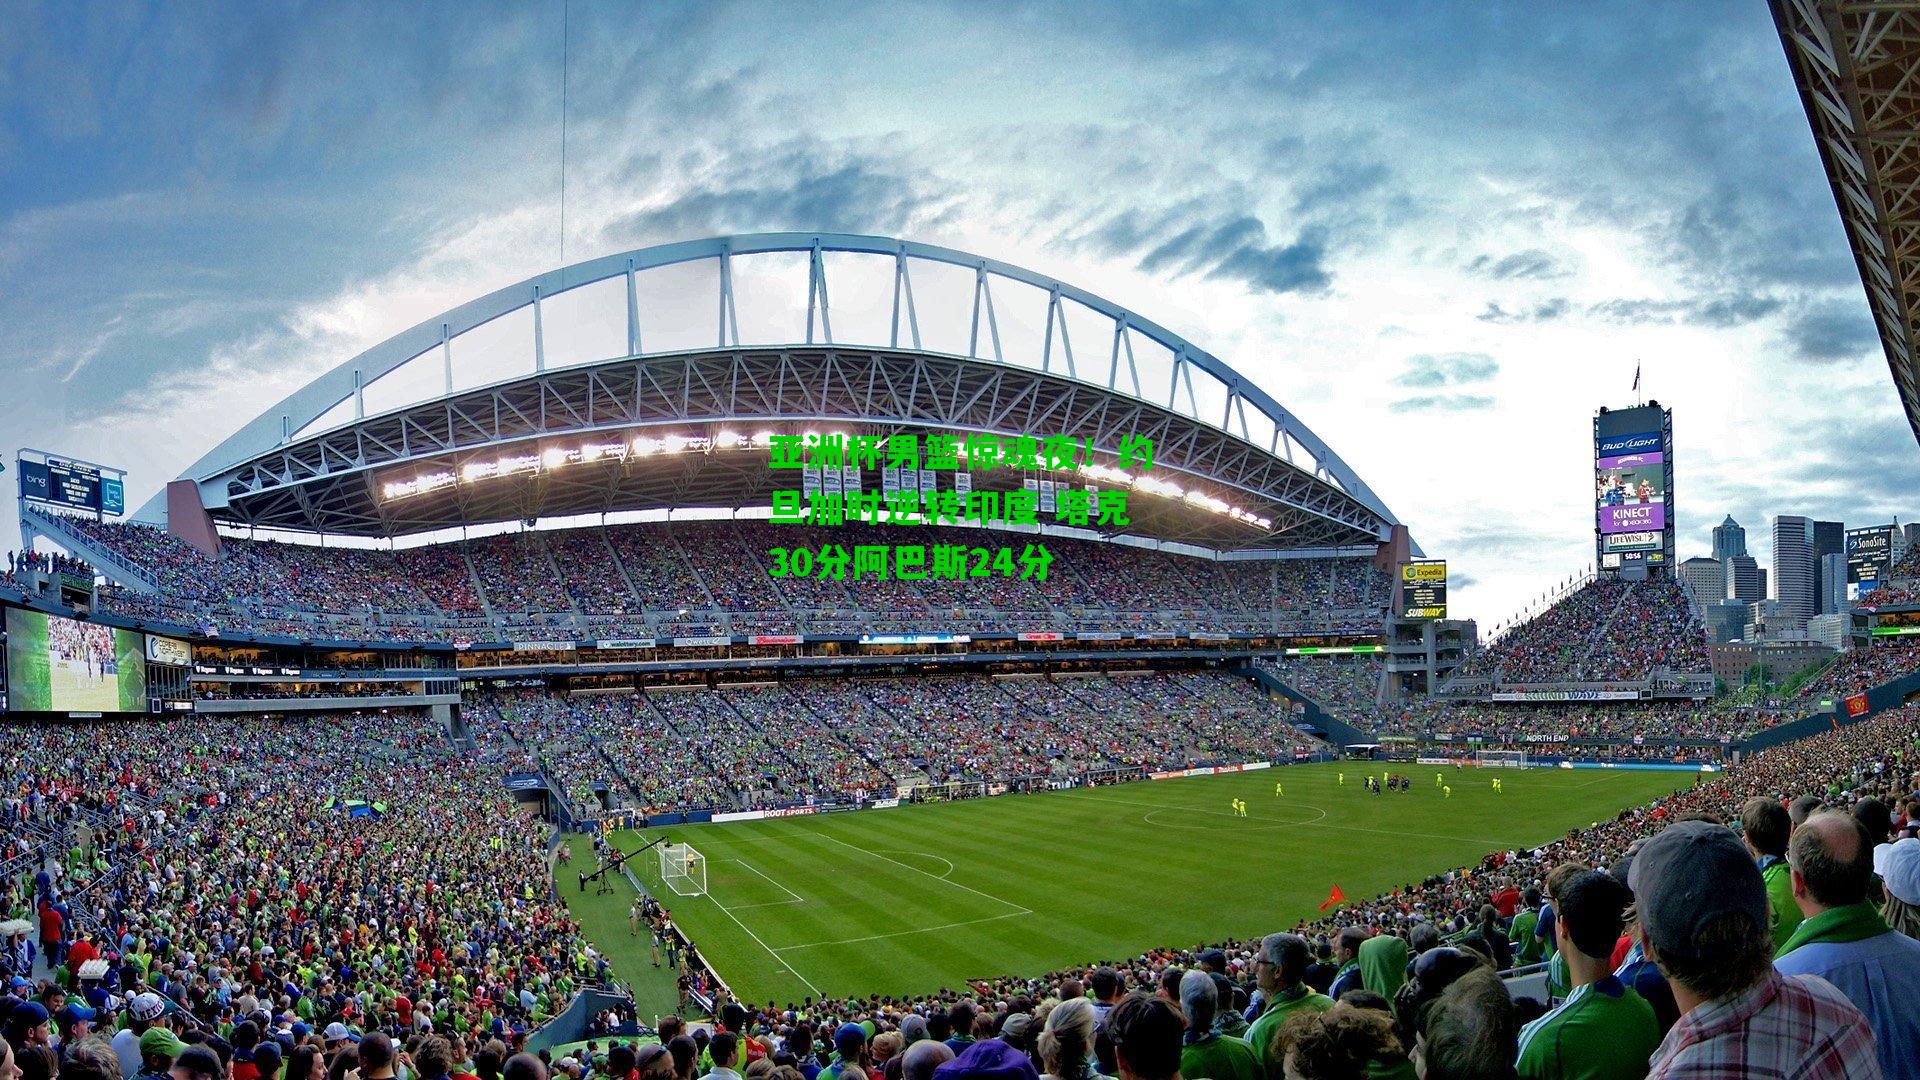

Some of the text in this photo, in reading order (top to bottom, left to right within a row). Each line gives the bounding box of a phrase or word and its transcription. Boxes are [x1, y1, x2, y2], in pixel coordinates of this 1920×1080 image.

[1602, 438, 1659, 450] BUD LIGHT
[27, 474, 46, 488] bing
[1613, 507, 1653, 519] KINECT
[1858, 535, 1886, 549] SonoSite
[1416, 569, 1443, 577] Expedia
[1405, 608, 1445, 618] SUBWAY
[519, 642, 567, 651] PINNACLE
[685, 638, 710, 646] Qwest
[1526, 734, 1569, 743] NORTH END
[764, 808, 786, 818] ROOT
